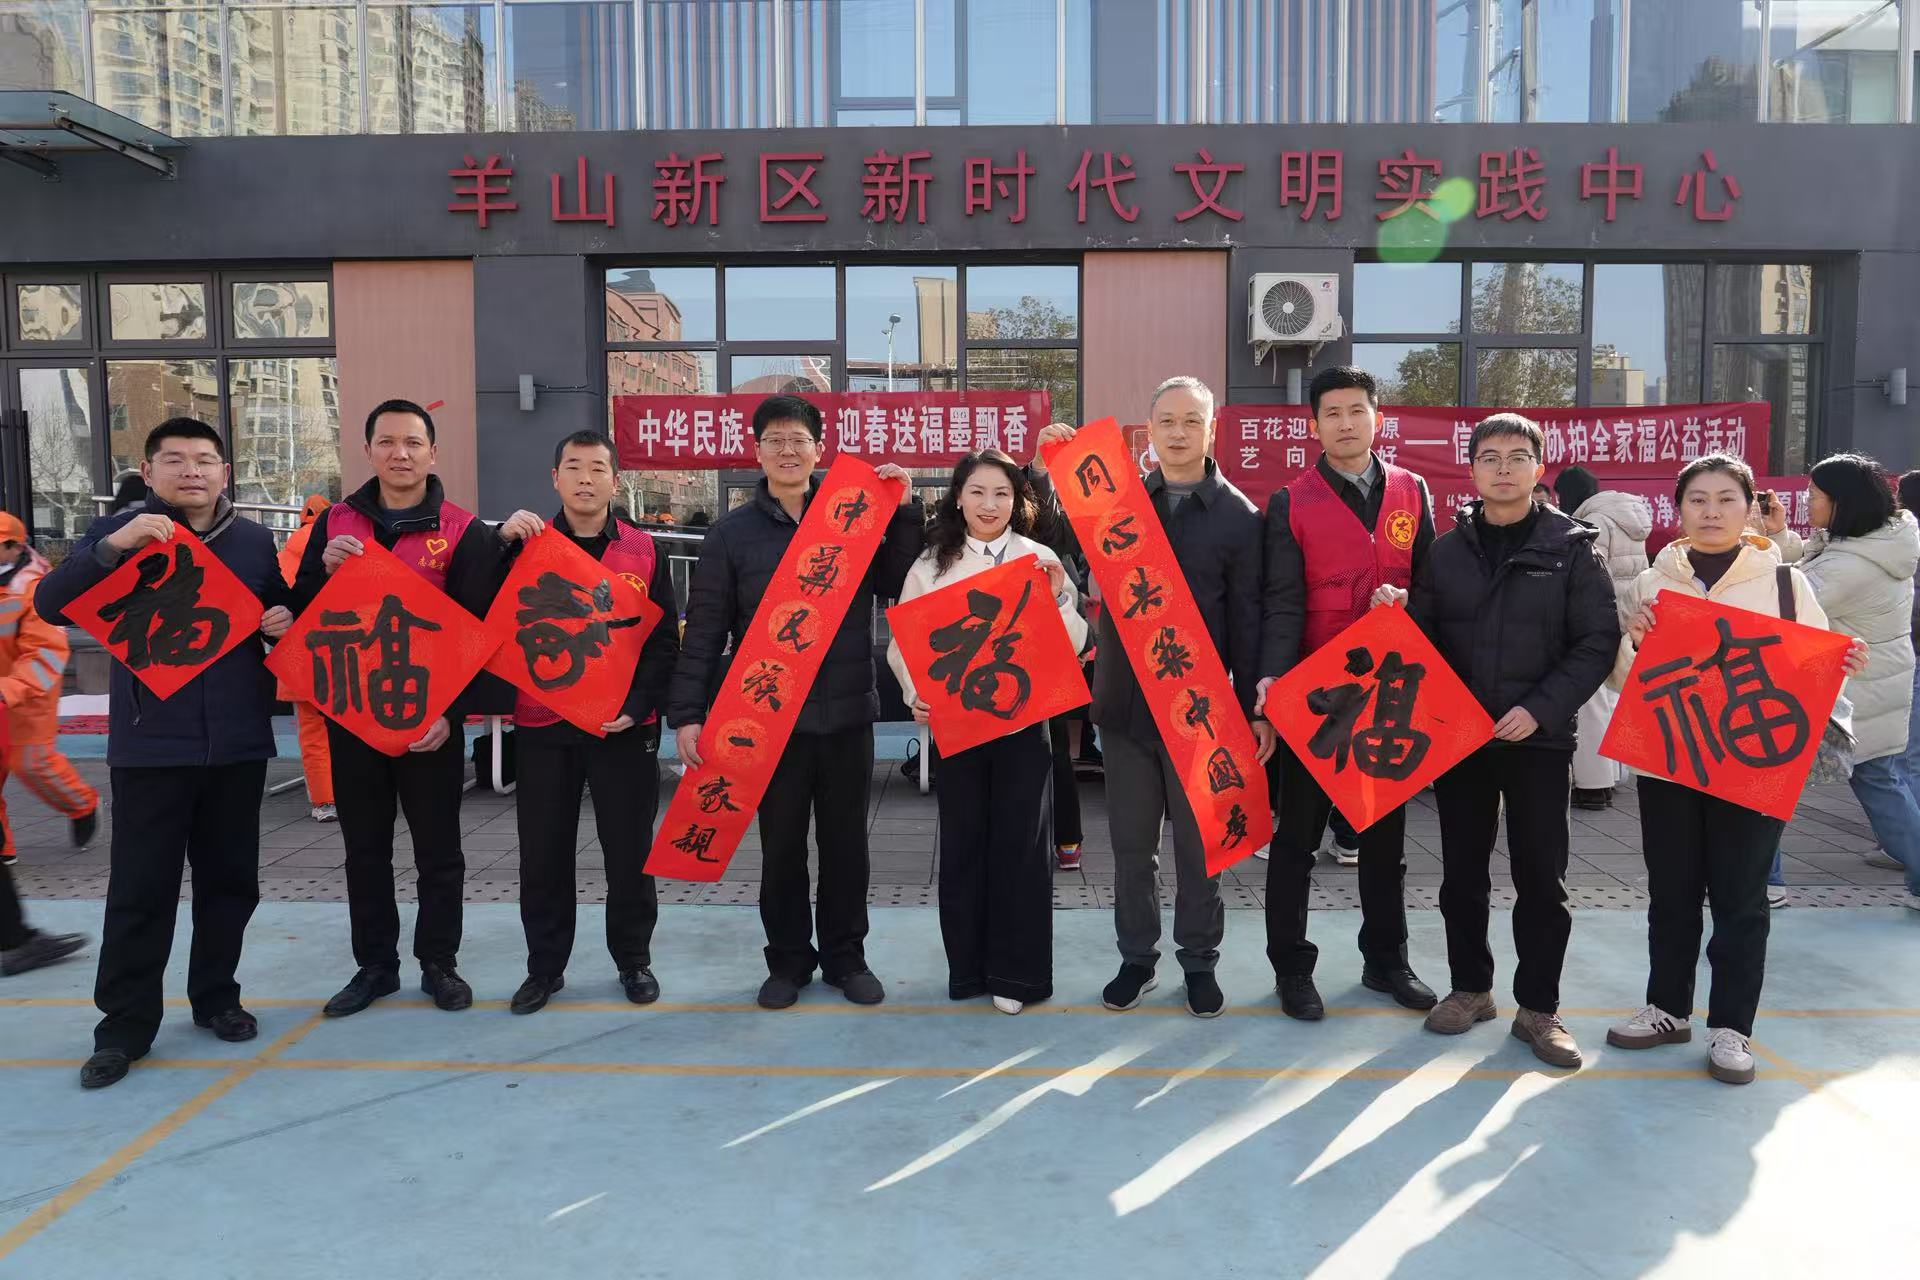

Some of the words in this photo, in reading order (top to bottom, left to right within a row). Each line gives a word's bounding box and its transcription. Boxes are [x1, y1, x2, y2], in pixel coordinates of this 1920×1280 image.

[448, 149, 1741, 229] 羊山新区新时代文明实践中心
[836, 404, 1028, 454] 迎春送福墨飘香
[97, 541, 230, 670] 福
[306, 593, 441, 730] 福
[927, 580, 1032, 720] 福
[1307, 646, 1431, 781] 福
[1639, 617, 1809, 787] 福
